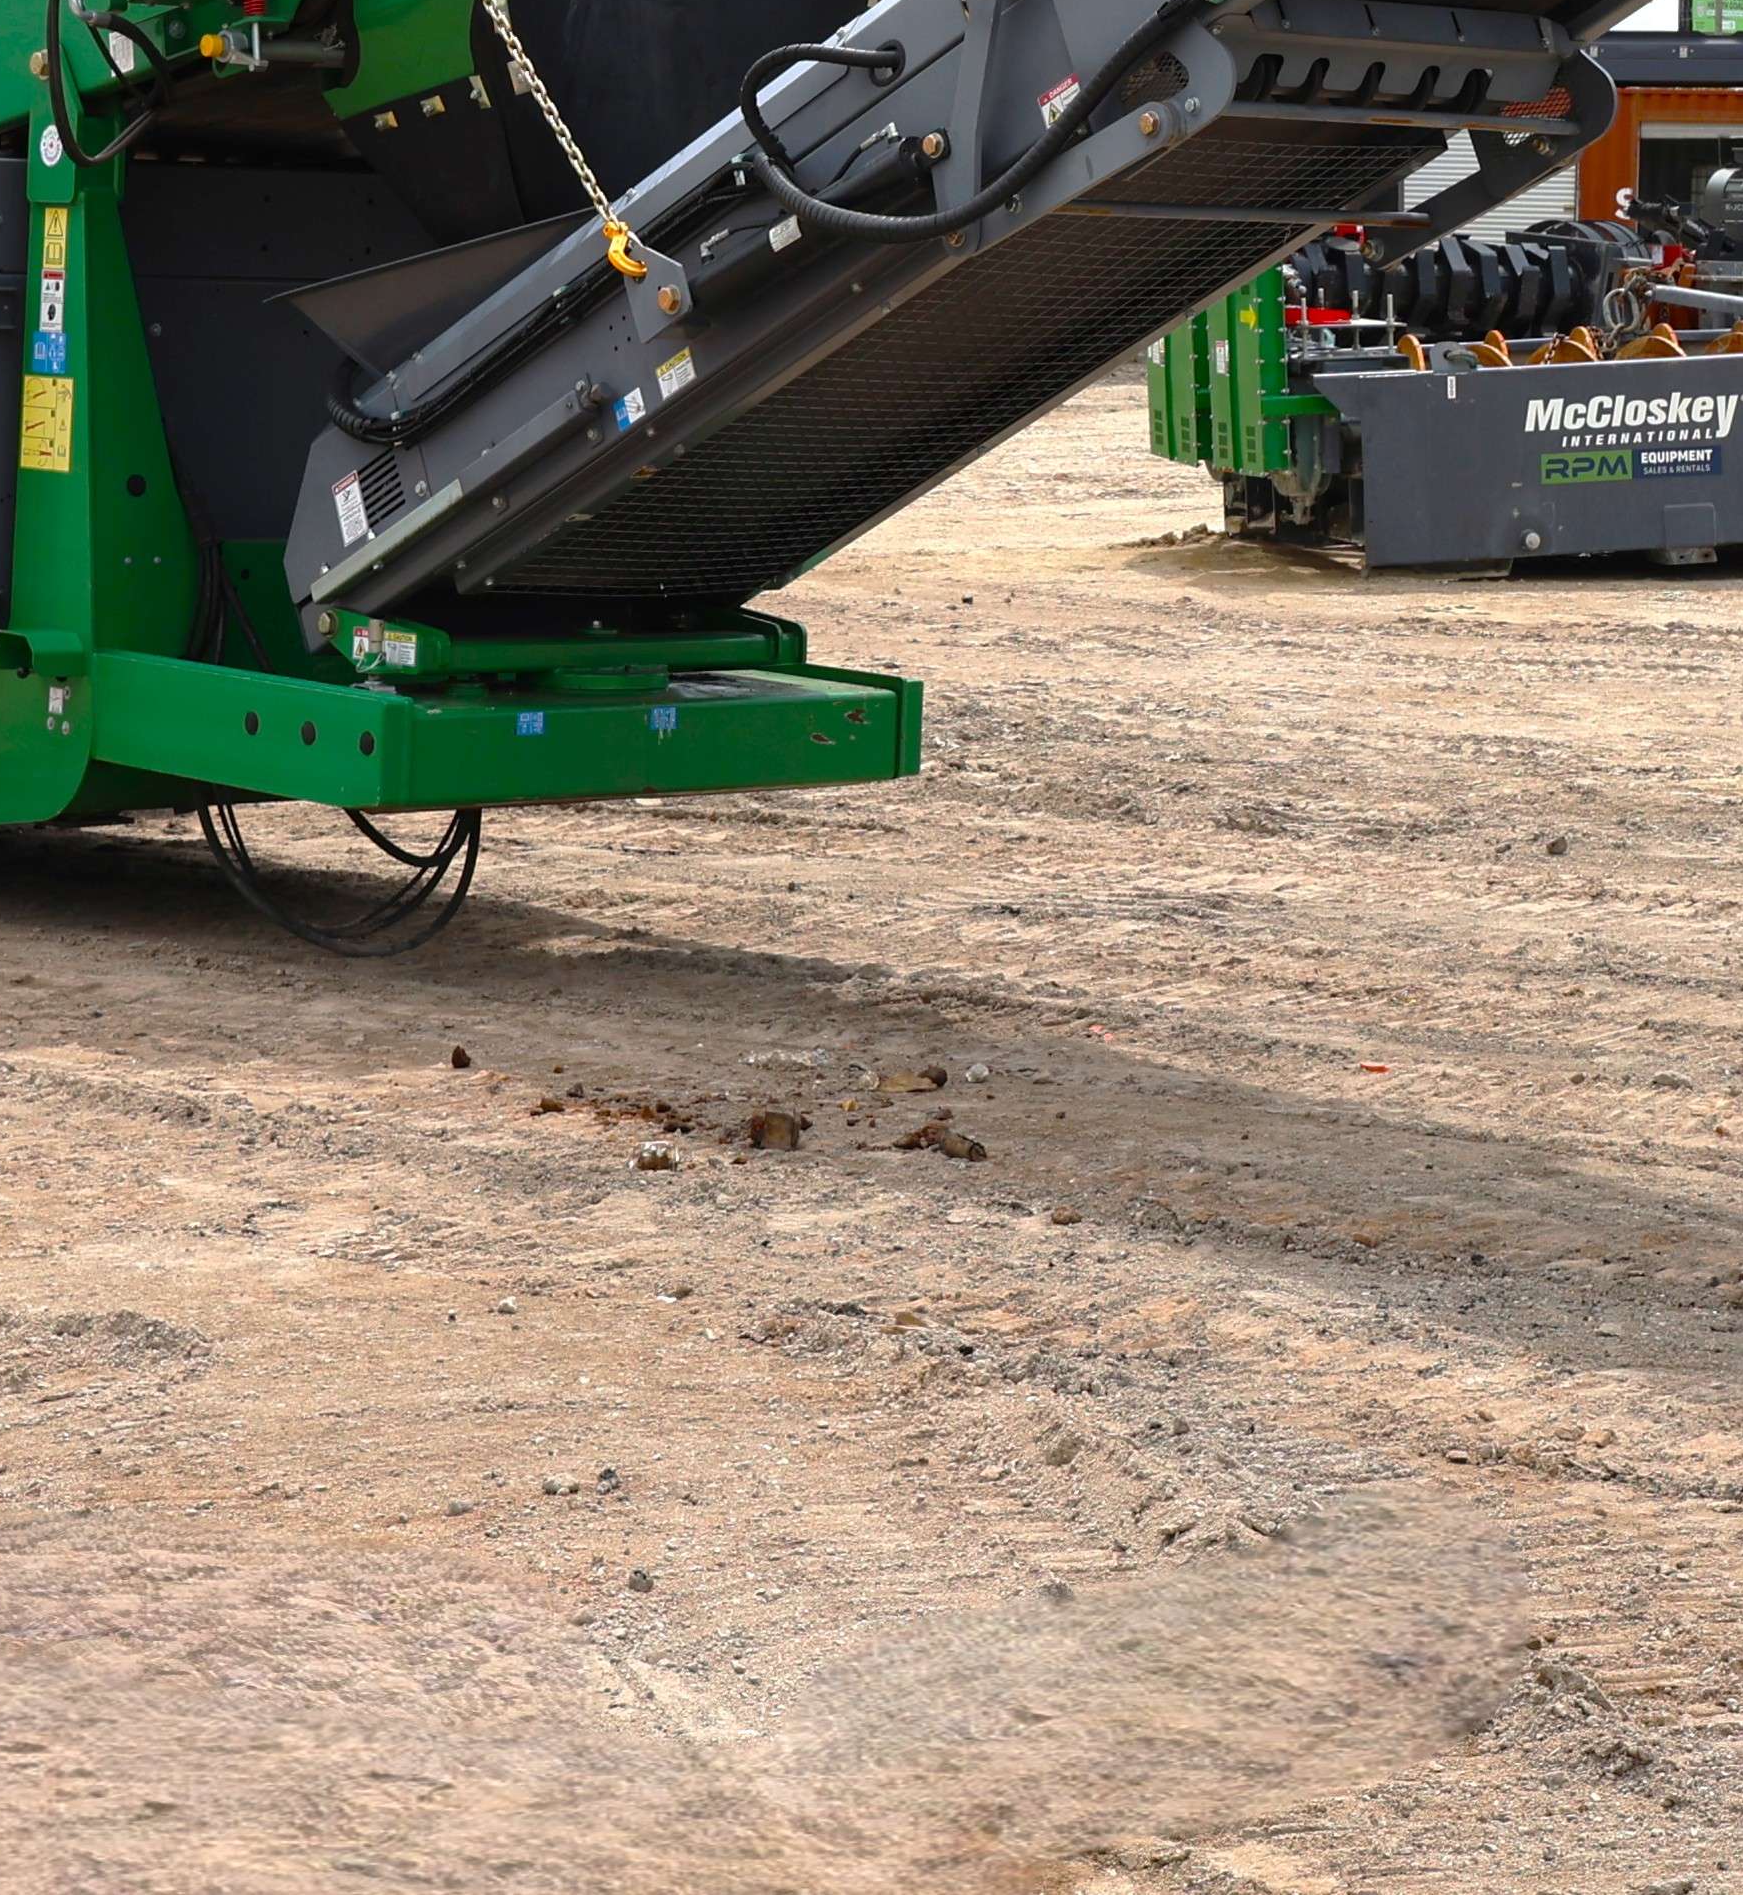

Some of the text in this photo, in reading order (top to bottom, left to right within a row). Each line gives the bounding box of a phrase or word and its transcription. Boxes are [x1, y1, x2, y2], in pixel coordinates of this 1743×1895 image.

[1524, 391, 1739, 438] McCloskey
[1562, 428, 1714, 448] INTERNATIONAL
[1640, 449, 1713, 464] EQUIPMENT
[1544, 455, 1628, 479] RPM
[1643, 464, 1711, 475] SALES & RENTALS
